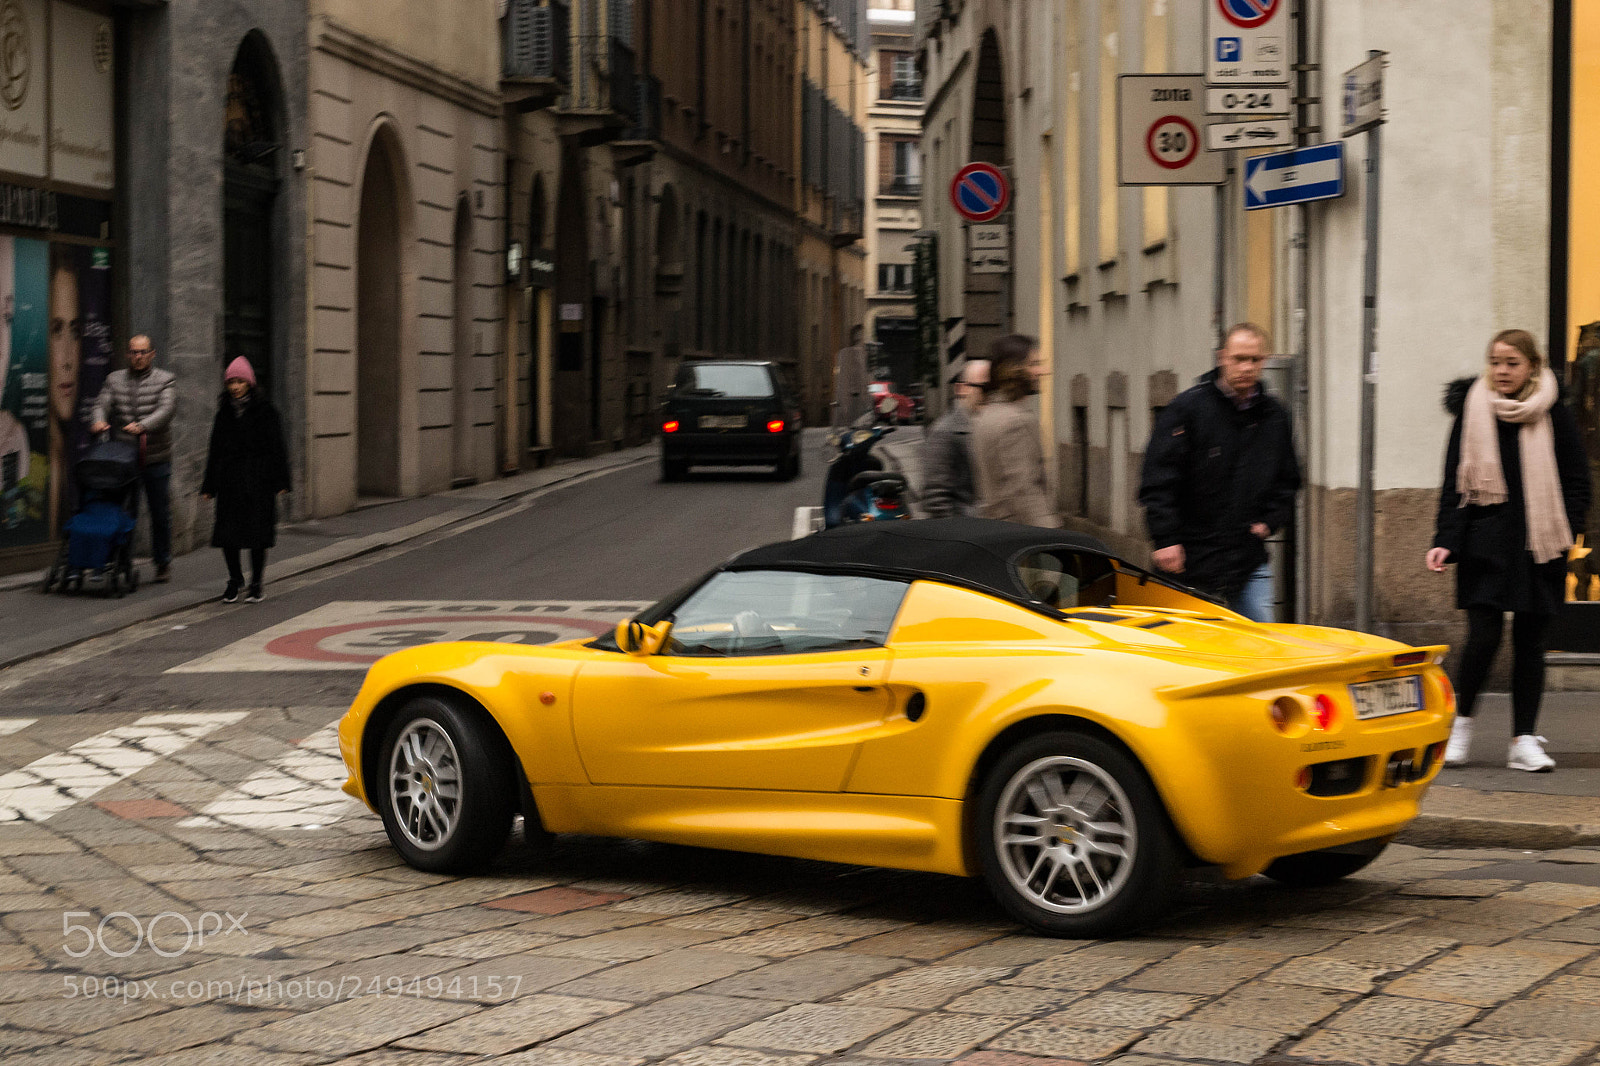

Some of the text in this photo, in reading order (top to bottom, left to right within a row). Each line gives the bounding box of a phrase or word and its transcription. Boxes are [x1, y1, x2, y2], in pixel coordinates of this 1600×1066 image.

[1219, 39, 1237, 59] P
[1151, 88, 1192, 102] zona
[1221, 92, 1273, 109] 0-24
[1158, 131, 1188, 153] 30
[377, 604, 642, 615] zona
[345, 630, 560, 648] 30
